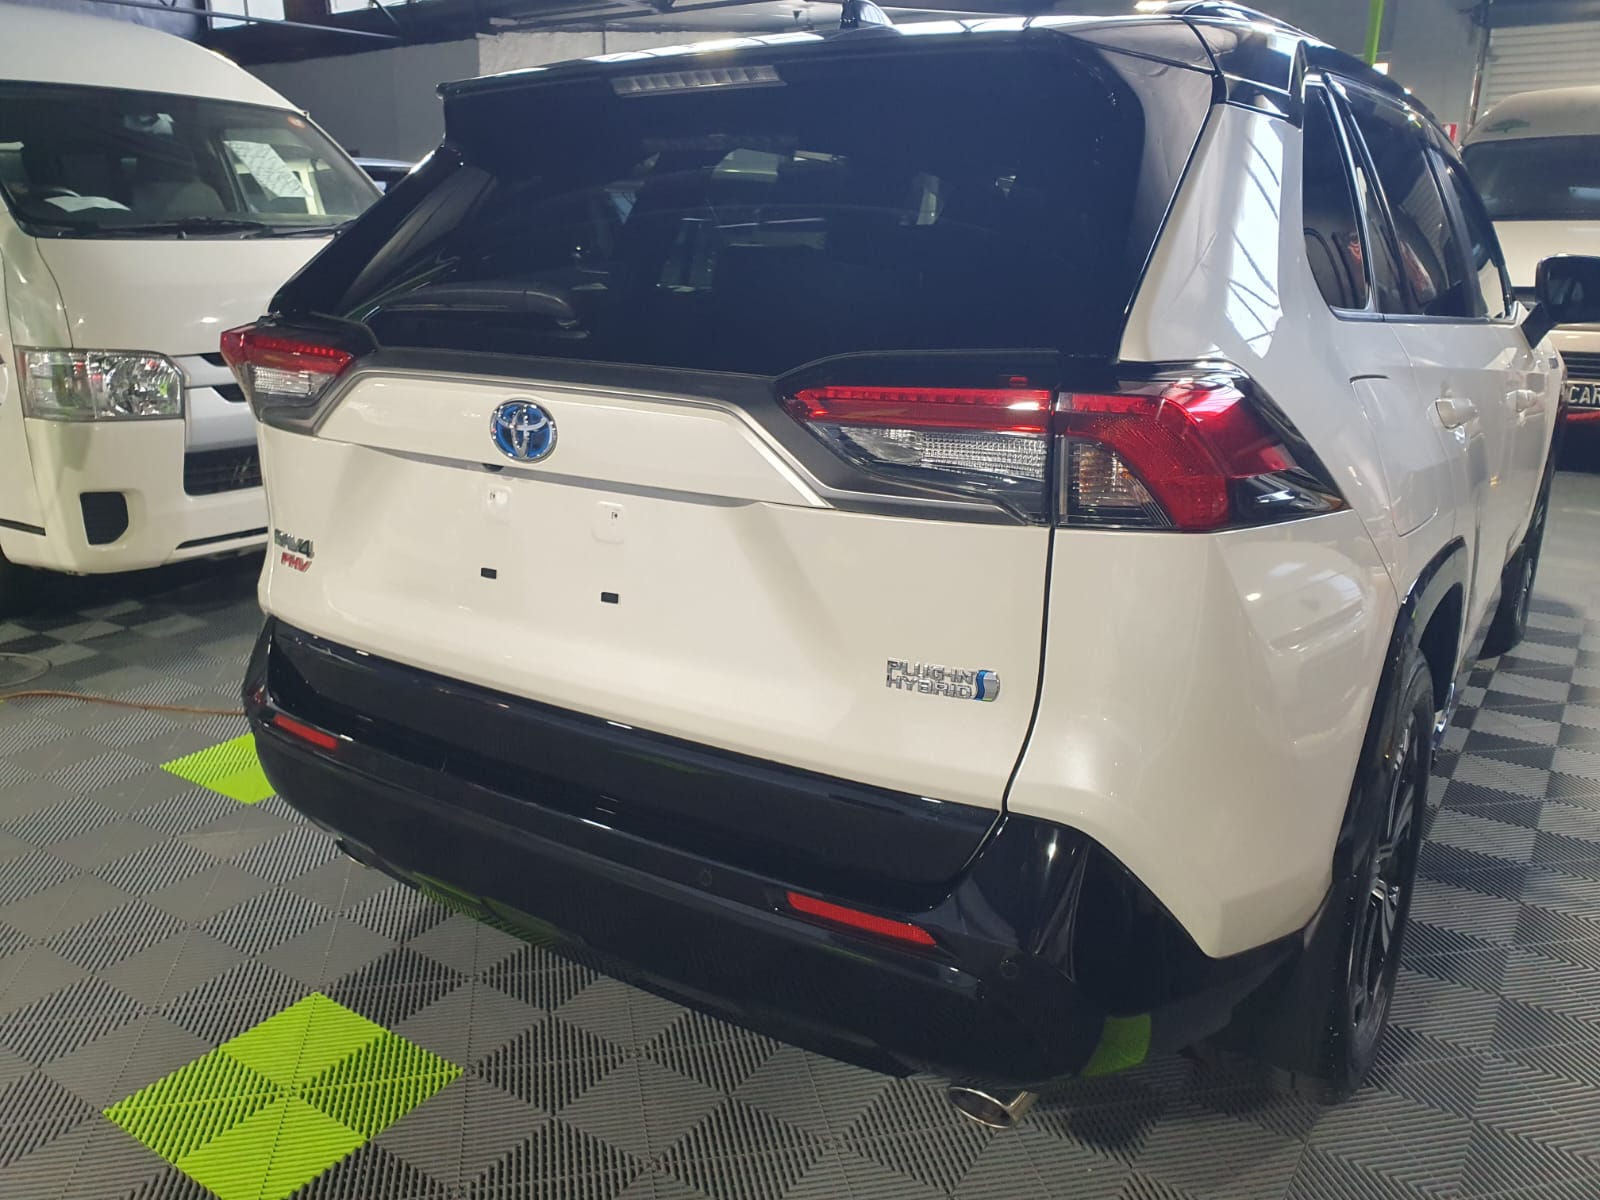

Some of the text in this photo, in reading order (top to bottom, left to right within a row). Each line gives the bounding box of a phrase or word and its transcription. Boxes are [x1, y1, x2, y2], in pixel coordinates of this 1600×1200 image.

[281, 552, 312, 573] PHV
[887, 658, 977, 685] PLUG-IN
[886, 674, 974, 700] HYBRID
